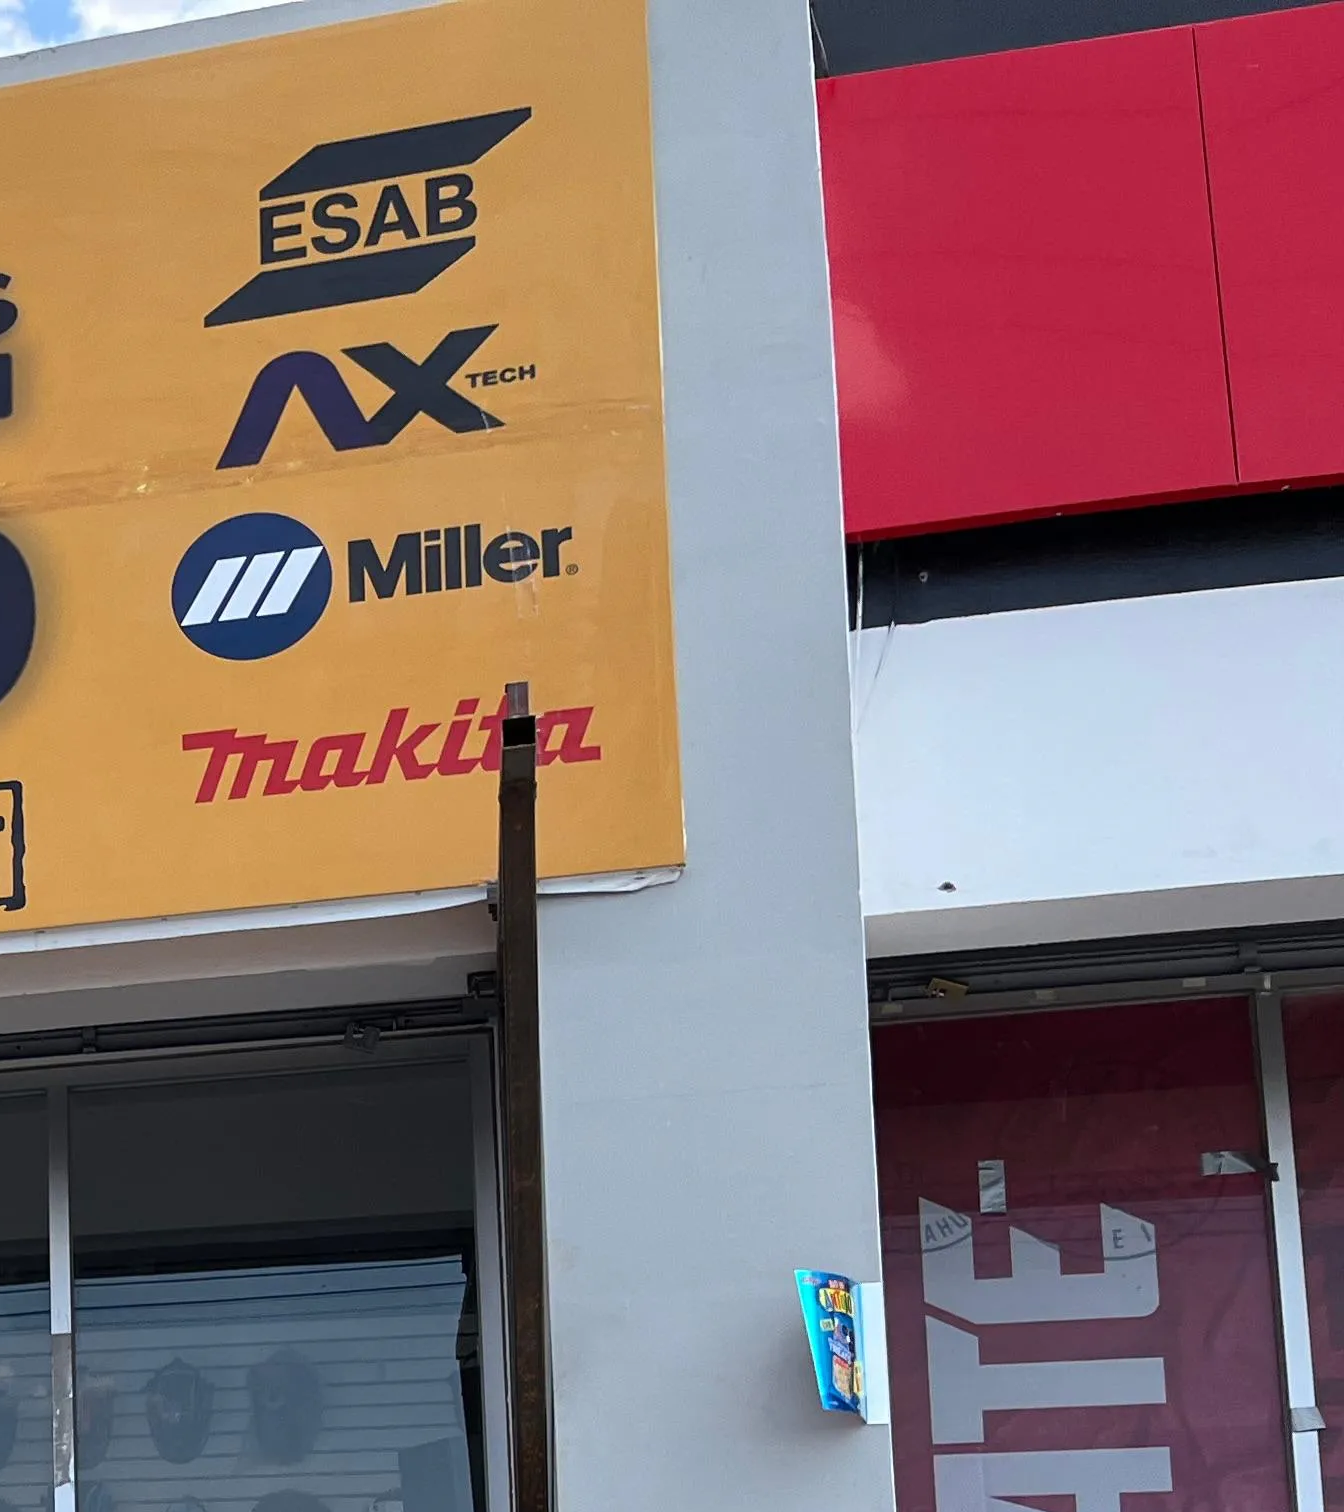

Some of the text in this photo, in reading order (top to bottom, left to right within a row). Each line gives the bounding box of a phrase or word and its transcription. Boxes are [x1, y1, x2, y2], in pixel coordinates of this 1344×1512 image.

[258, 172, 478, 265] ESAB
[464, 363, 537, 389] TECH
[347, 523, 573, 603] Miller
